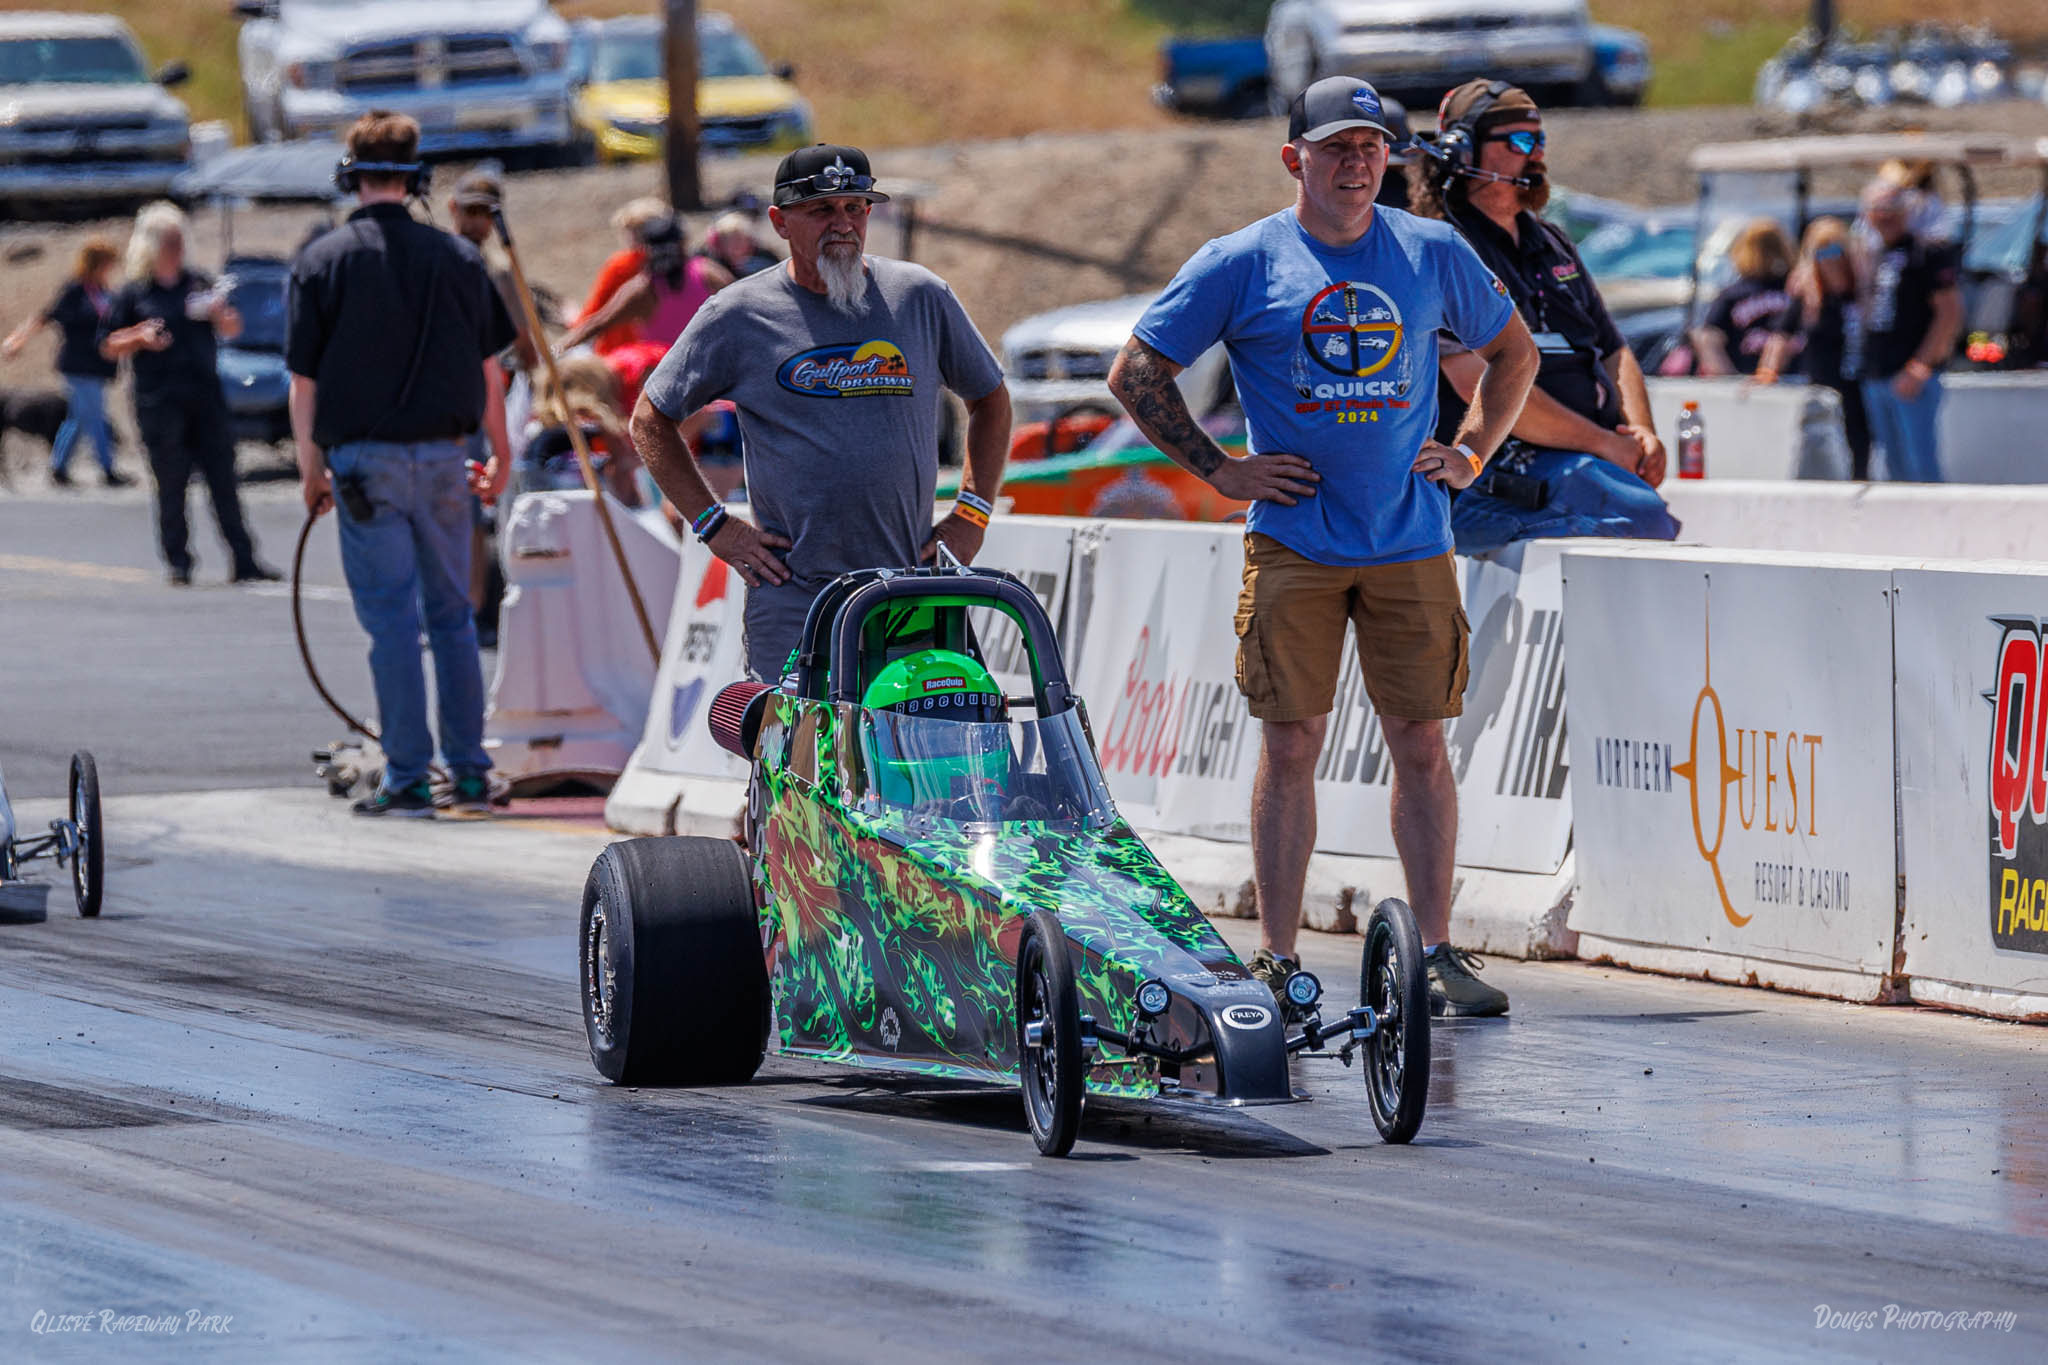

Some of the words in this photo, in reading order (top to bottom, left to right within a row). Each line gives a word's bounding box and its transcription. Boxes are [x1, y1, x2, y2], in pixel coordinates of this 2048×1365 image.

[793, 356, 886, 387] Gulfport
[839, 376, 913, 389] DRAGWAY
[1314, 381, 1397, 399] QUICK
[1336, 411, 1378, 424] 2024
[925, 678, 963, 690] RaceQuip
[1102, 624, 1192, 779] Coors
[1177, 680, 1248, 780] LIGHT
[1596, 737, 1672, 793] NORTHERN
[1755, 860, 1794, 905] RESORT
[1810, 867, 1850, 912] CASINO
[1230, 1010, 1264, 1021] FREYA
